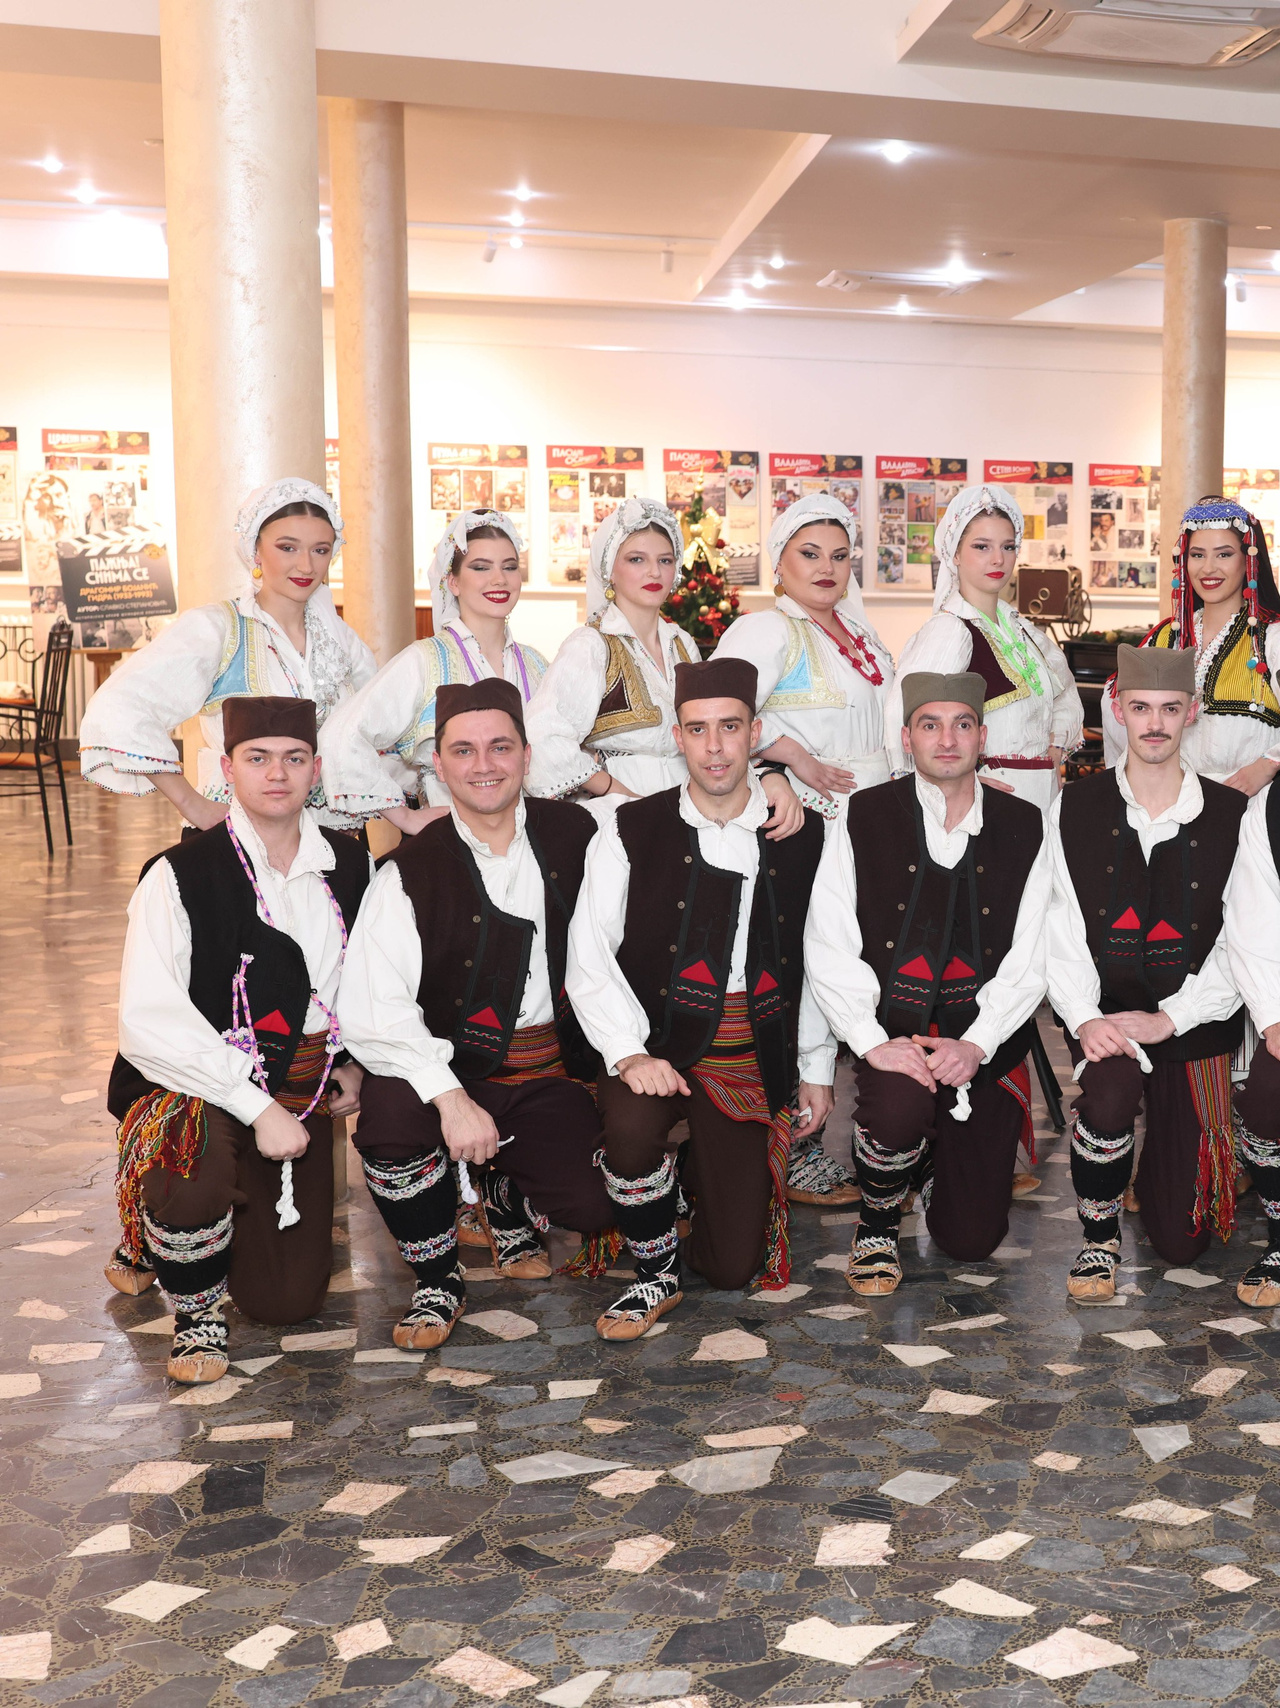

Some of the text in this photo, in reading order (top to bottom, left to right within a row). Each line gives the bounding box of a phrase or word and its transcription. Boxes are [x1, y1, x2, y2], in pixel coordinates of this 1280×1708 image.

[89, 555, 141, 572] ПАЖЊА!
[85, 567, 150, 585] СНИМА СЕ
